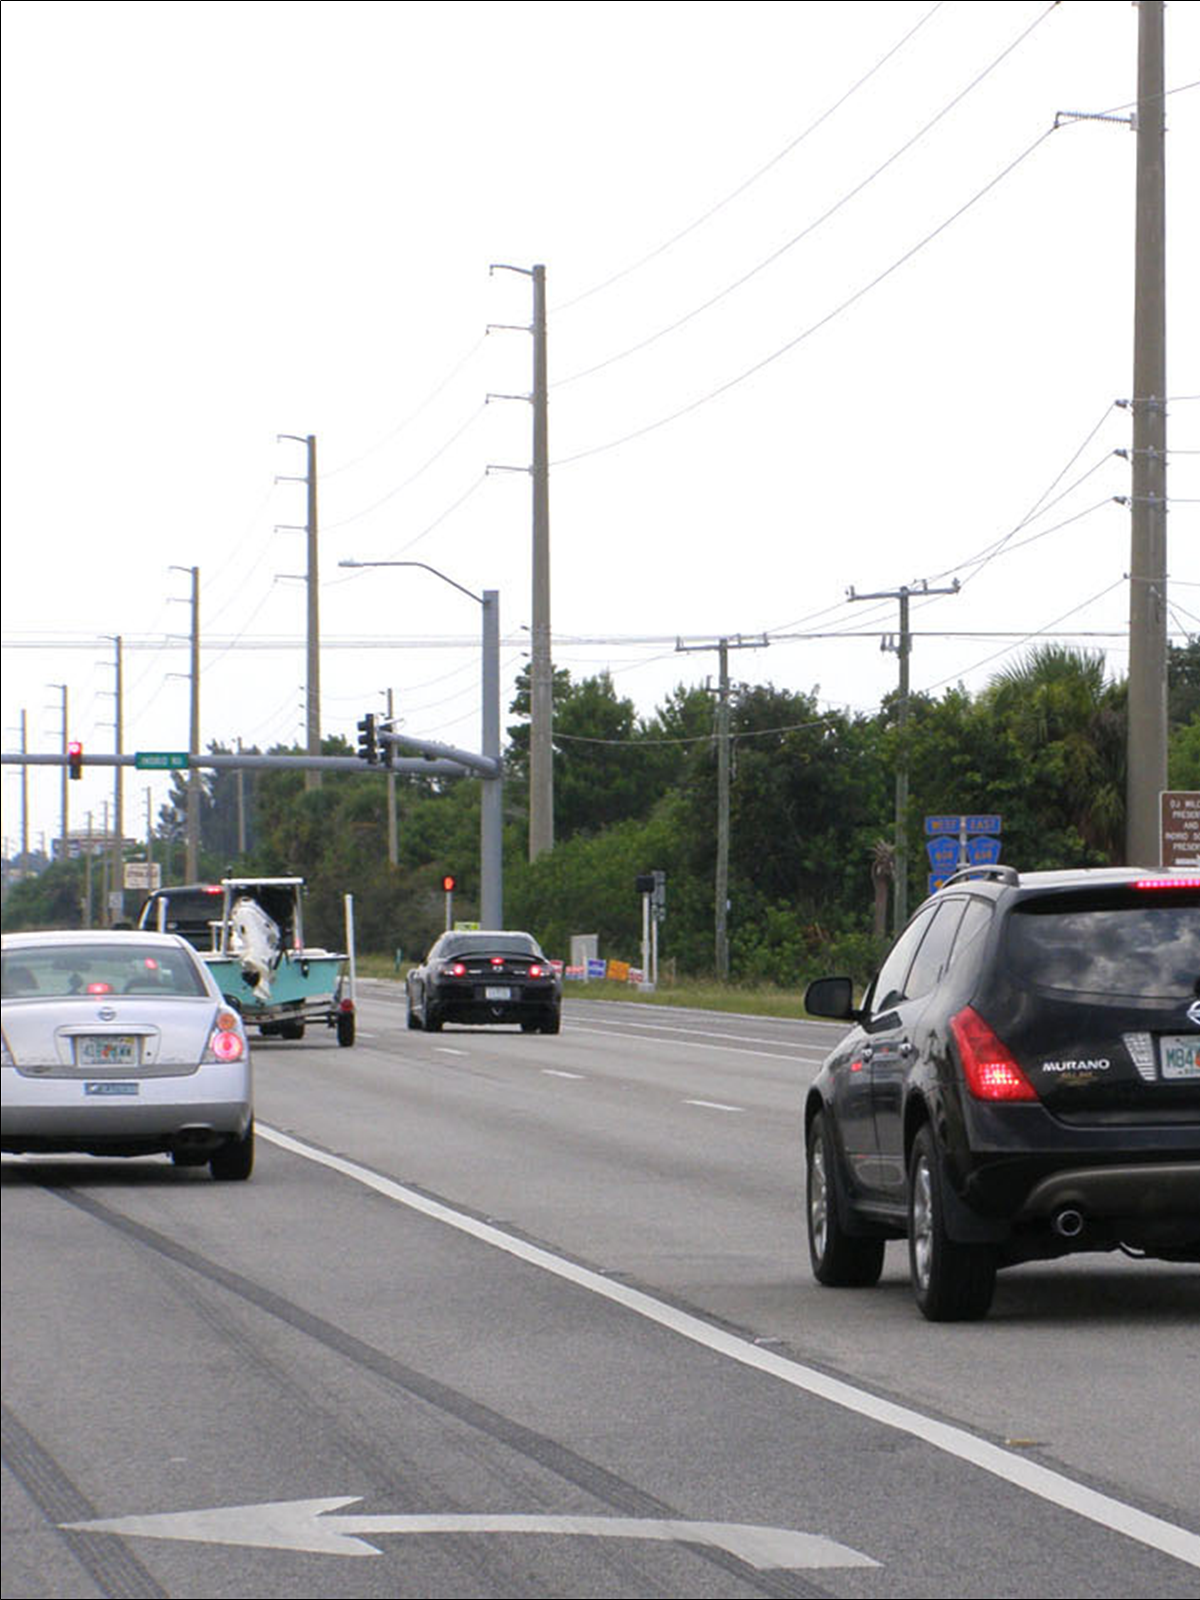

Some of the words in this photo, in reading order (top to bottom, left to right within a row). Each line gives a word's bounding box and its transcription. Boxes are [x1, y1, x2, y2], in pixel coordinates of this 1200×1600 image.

[970, 820, 997, 830] EAST
[1184, 821, 1199, 830] AND
[1042, 1059, 1110, 1072] MURANO
